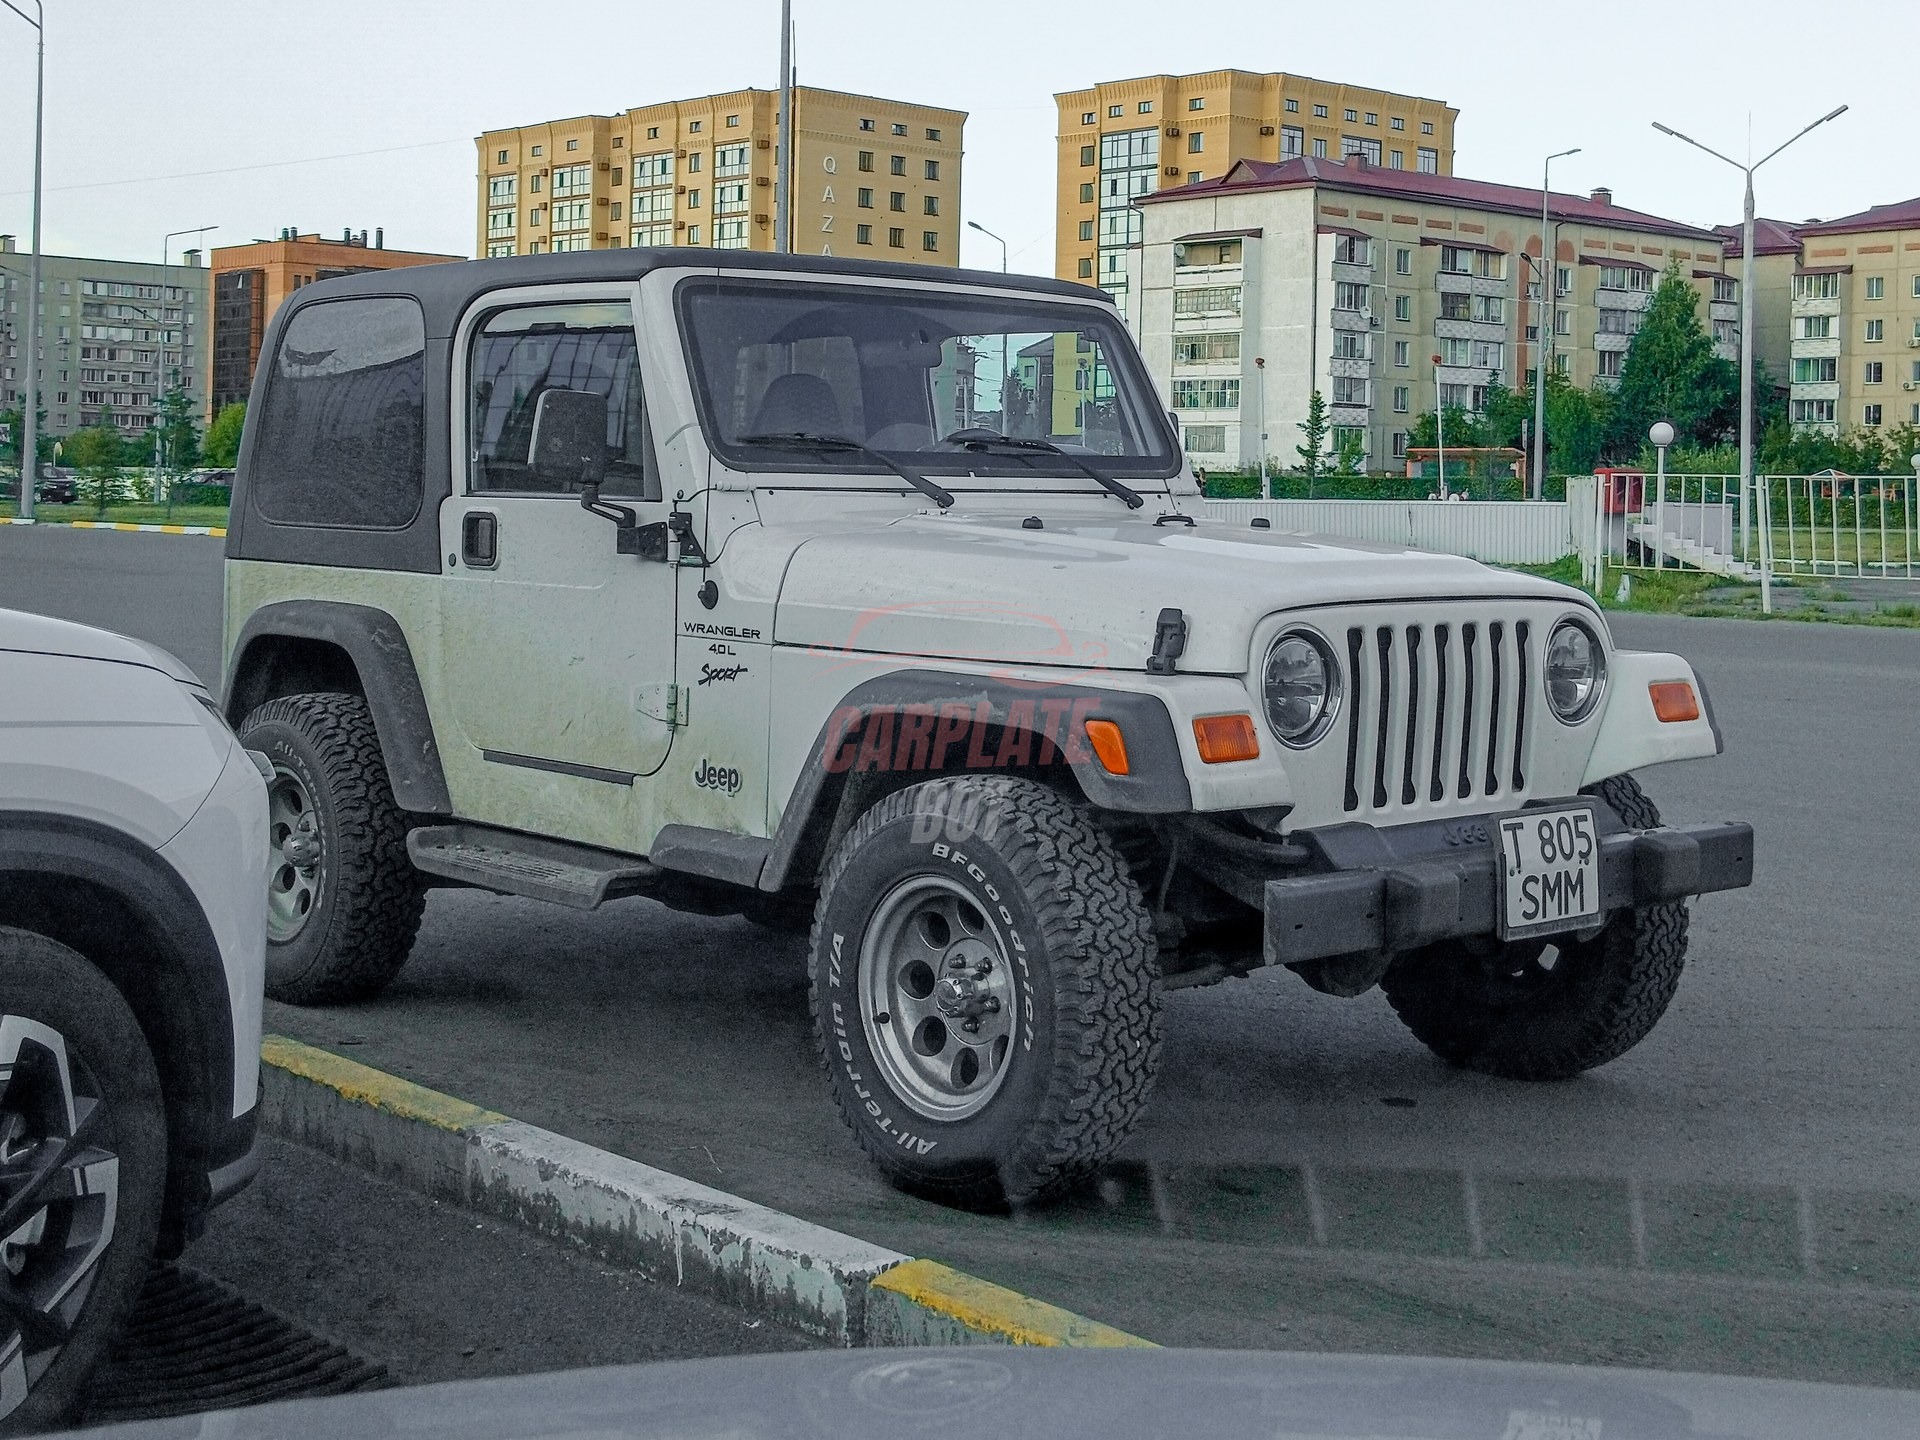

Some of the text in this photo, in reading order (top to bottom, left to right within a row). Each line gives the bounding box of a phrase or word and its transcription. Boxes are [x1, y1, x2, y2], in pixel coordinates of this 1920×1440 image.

[684, 622, 761, 640] WRANGLER
[698, 663, 749, 687] Sport
[694, 758, 742, 796] Jeep
[1502, 814, 1593, 869] T 805
[1521, 867, 1585, 920] SMM
[932, 842, 1035, 1052] BFGoodrich
[829, 932, 938, 1155] All-Terrain T/A
